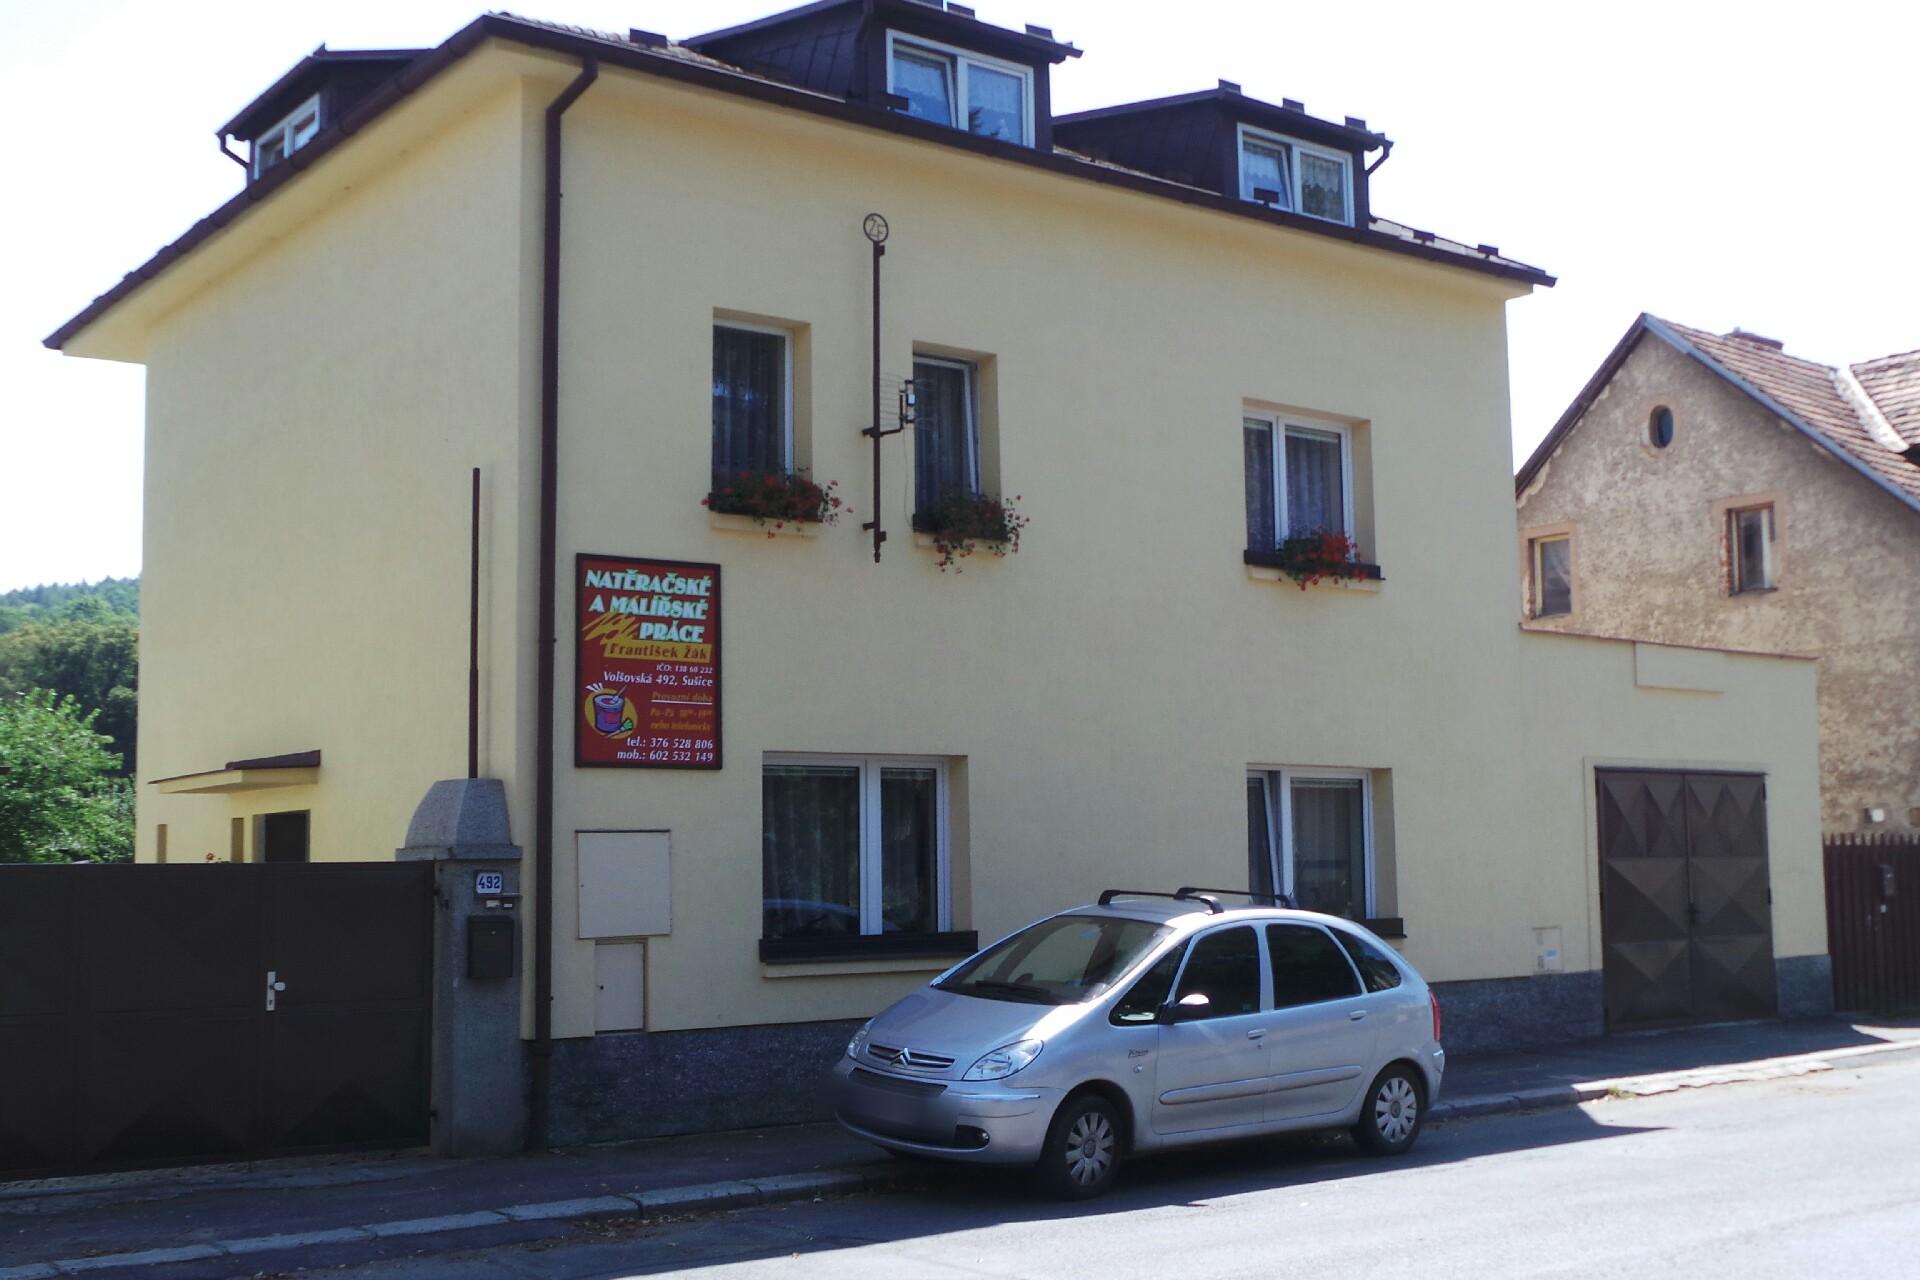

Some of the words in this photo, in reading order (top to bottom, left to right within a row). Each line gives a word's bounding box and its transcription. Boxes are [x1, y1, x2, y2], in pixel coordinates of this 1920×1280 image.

[585, 569, 712, 596] NATĚRAČSKÉ
[588, 594, 605, 612] A
[639, 620, 705, 643] PRÁCE
[609, 643, 678, 658] František
[683, 646, 708, 660] Žák
[603, 671, 652, 684] Volšovská
[656, 674, 678, 687] 492,
[682, 675, 713, 687] Sušice
[627, 736, 646, 748] tel.:
[650, 737, 669, 748] 376
[672, 738, 691, 749] 528
[694, 739, 713, 749] 806
[616, 750, 646, 760] mob.:
[649, 750, 669, 760] 602
[672, 751, 691, 761] 532
[695, 751, 713, 762] 149
[478, 875, 500, 889] 492
